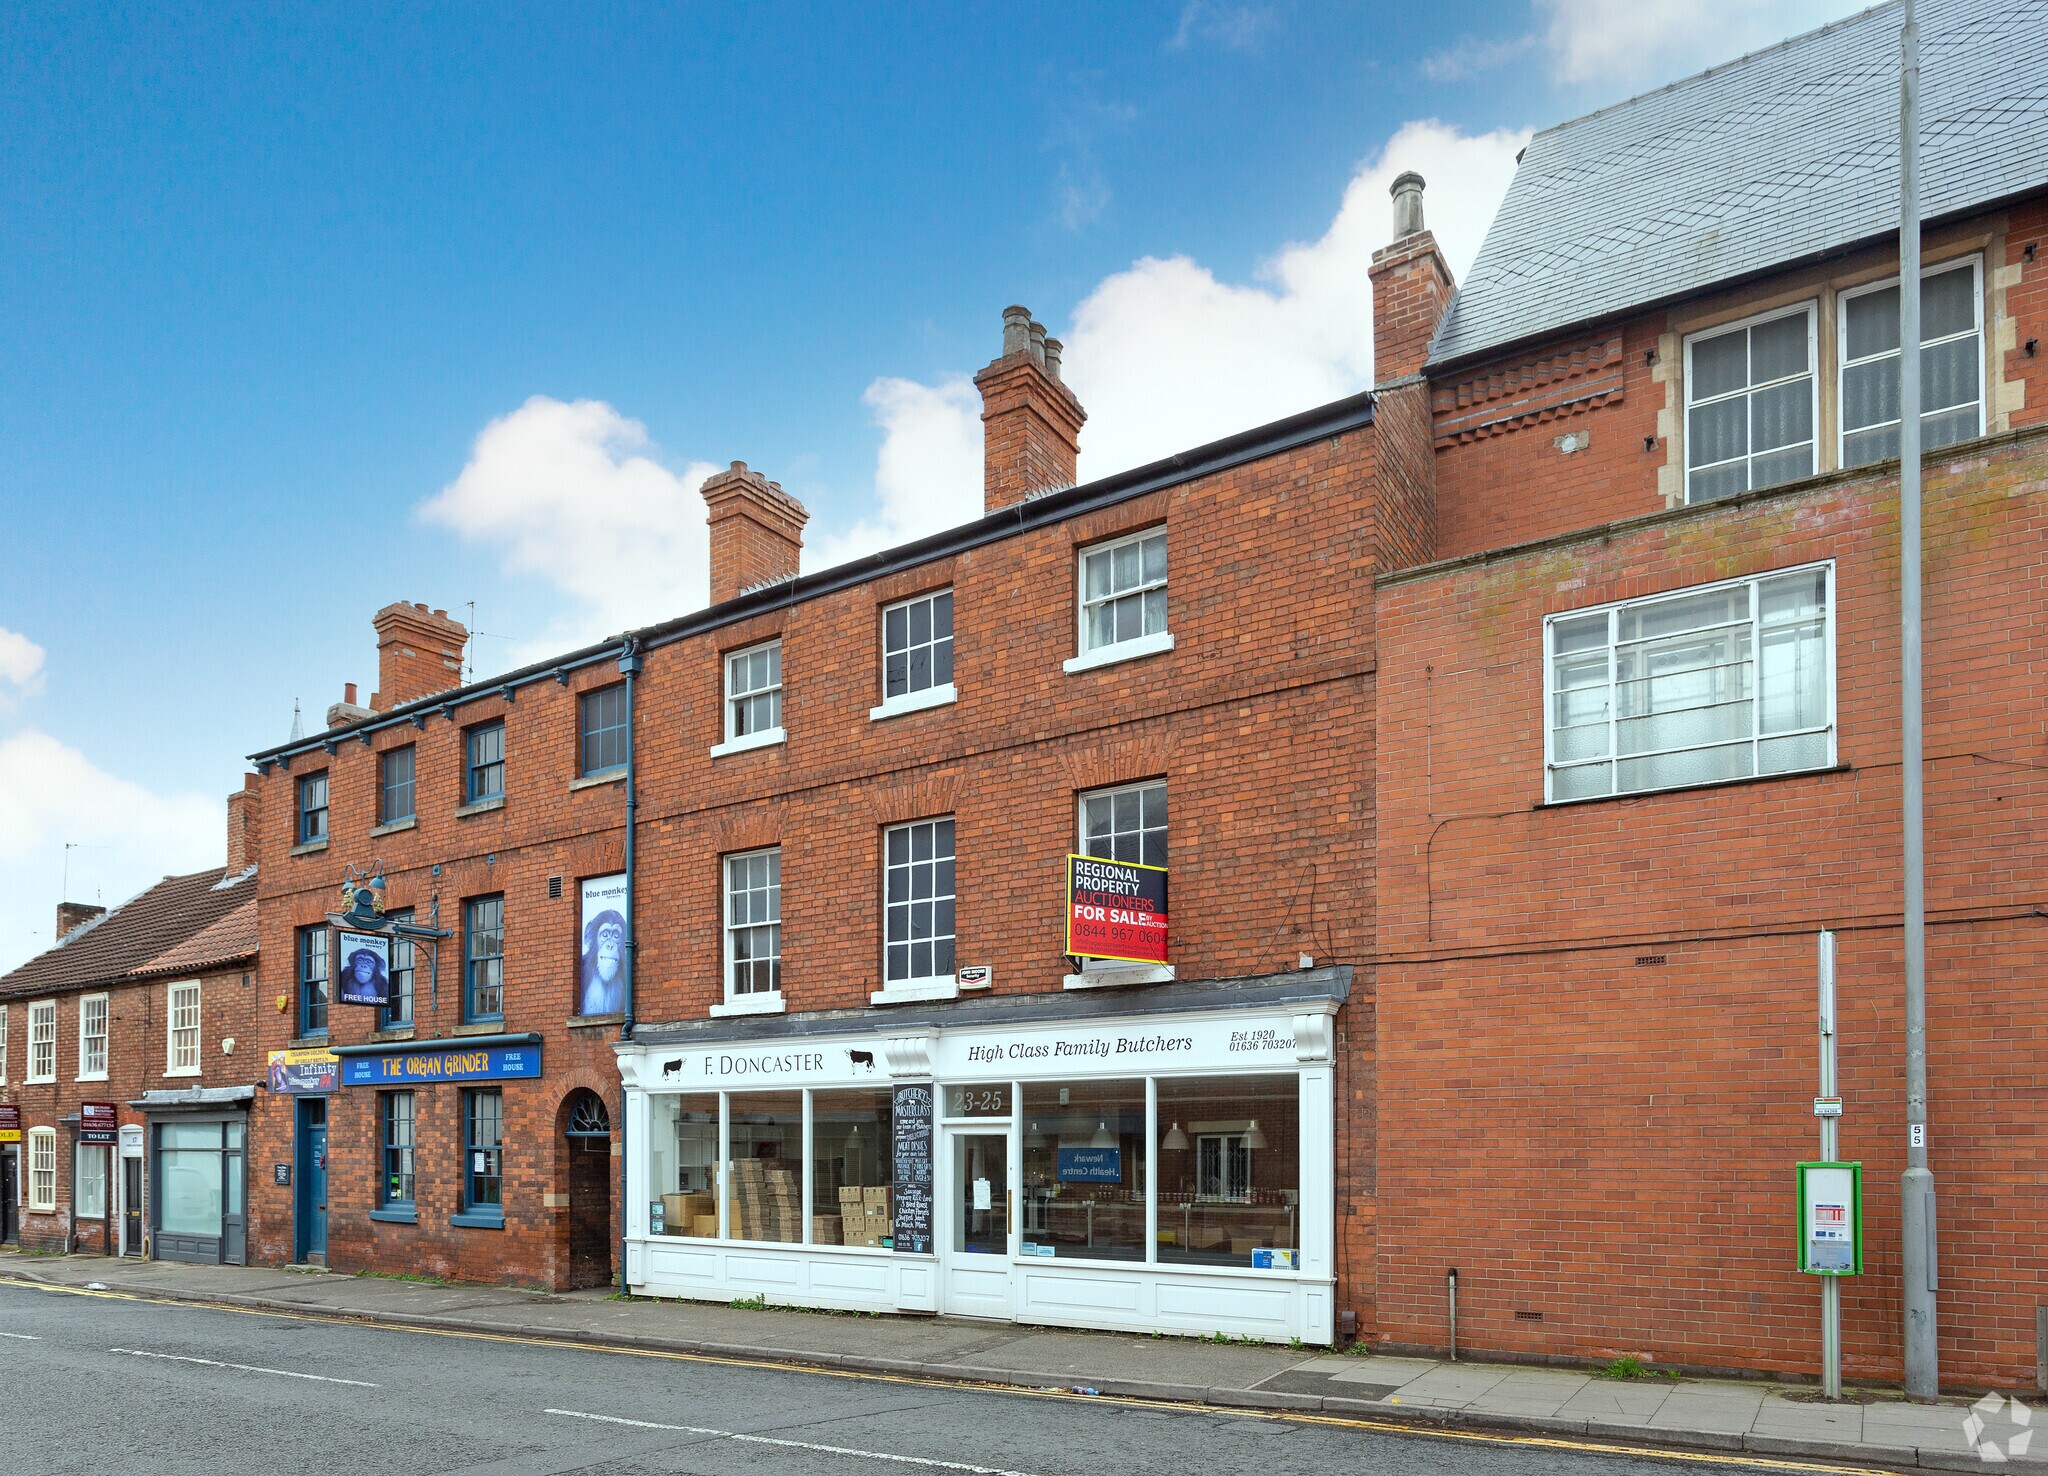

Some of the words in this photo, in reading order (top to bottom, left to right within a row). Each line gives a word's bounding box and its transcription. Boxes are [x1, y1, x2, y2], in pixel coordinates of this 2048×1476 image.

[1076, 861, 1140, 883] REGIONAL
[586, 890, 600, 898] blue
[1076, 875, 1140, 896] PROPERTY
[1074, 890, 1155, 912] AUCTIONEERS
[1074, 905, 1106, 922] FOR
[1110, 908, 1147, 926] SALE
[343, 934, 359, 943] blue
[360, 938, 387, 947] monkey
[1074, 923, 1106, 938] 0844
[1111, 927, 1134, 941] 967
[1229, 1041, 1258, 1052] 01636
[1262, 1038, 1297, 1050] 703207
[1230, 1031, 1248, 1041] Est
[1252, 1030, 1275, 1040] 1920
[968, 1045, 1004, 1063] High
[1008, 1044, 1050, 1058] Class
[1054, 1040, 1110, 1057] Family
[1116, 1036, 1193, 1053] Butchers
[300, 1062, 336, 1076] Infinity
[382, 1058, 403, 1076] THE
[406, 1056, 441, 1077] ORGAN
[444, 1052, 488, 1076] GRINDER
[705, 1057, 713, 1075] F.
[720, 1054, 823, 1074] DONCASTER
[953, 1091, 1002, 1111] 23-25
[1914, 1136, 1921, 1144] 5
